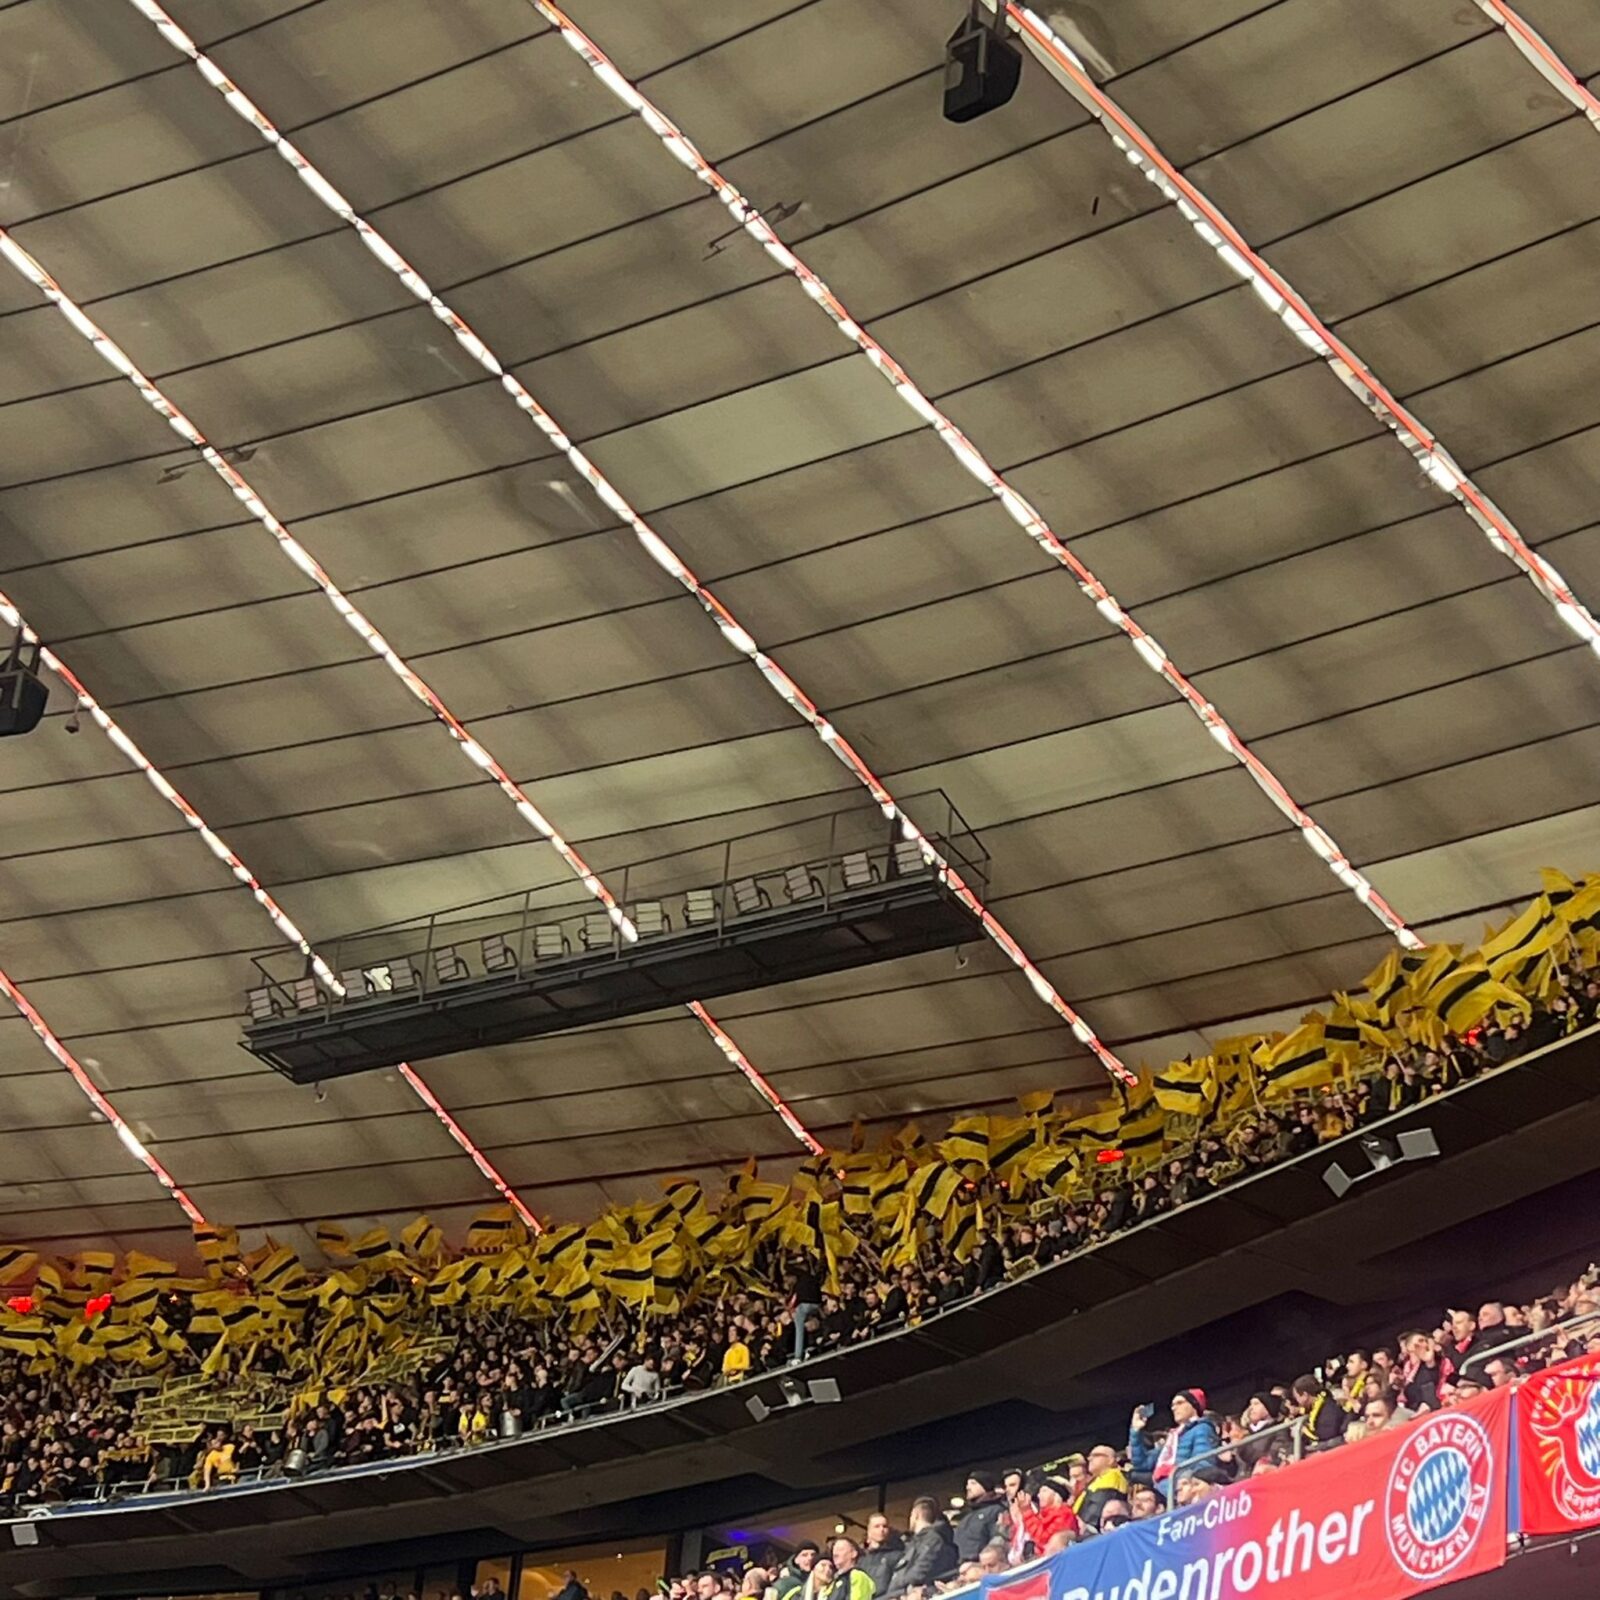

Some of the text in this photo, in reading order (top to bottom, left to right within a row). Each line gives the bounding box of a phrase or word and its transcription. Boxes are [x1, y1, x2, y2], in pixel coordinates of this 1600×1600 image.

[1394, 1422, 1484, 1492] FC BAYERN
[1063, 1498, 1375, 1600] denrother
[1156, 1489, 1252, 1546] Fan-Club
